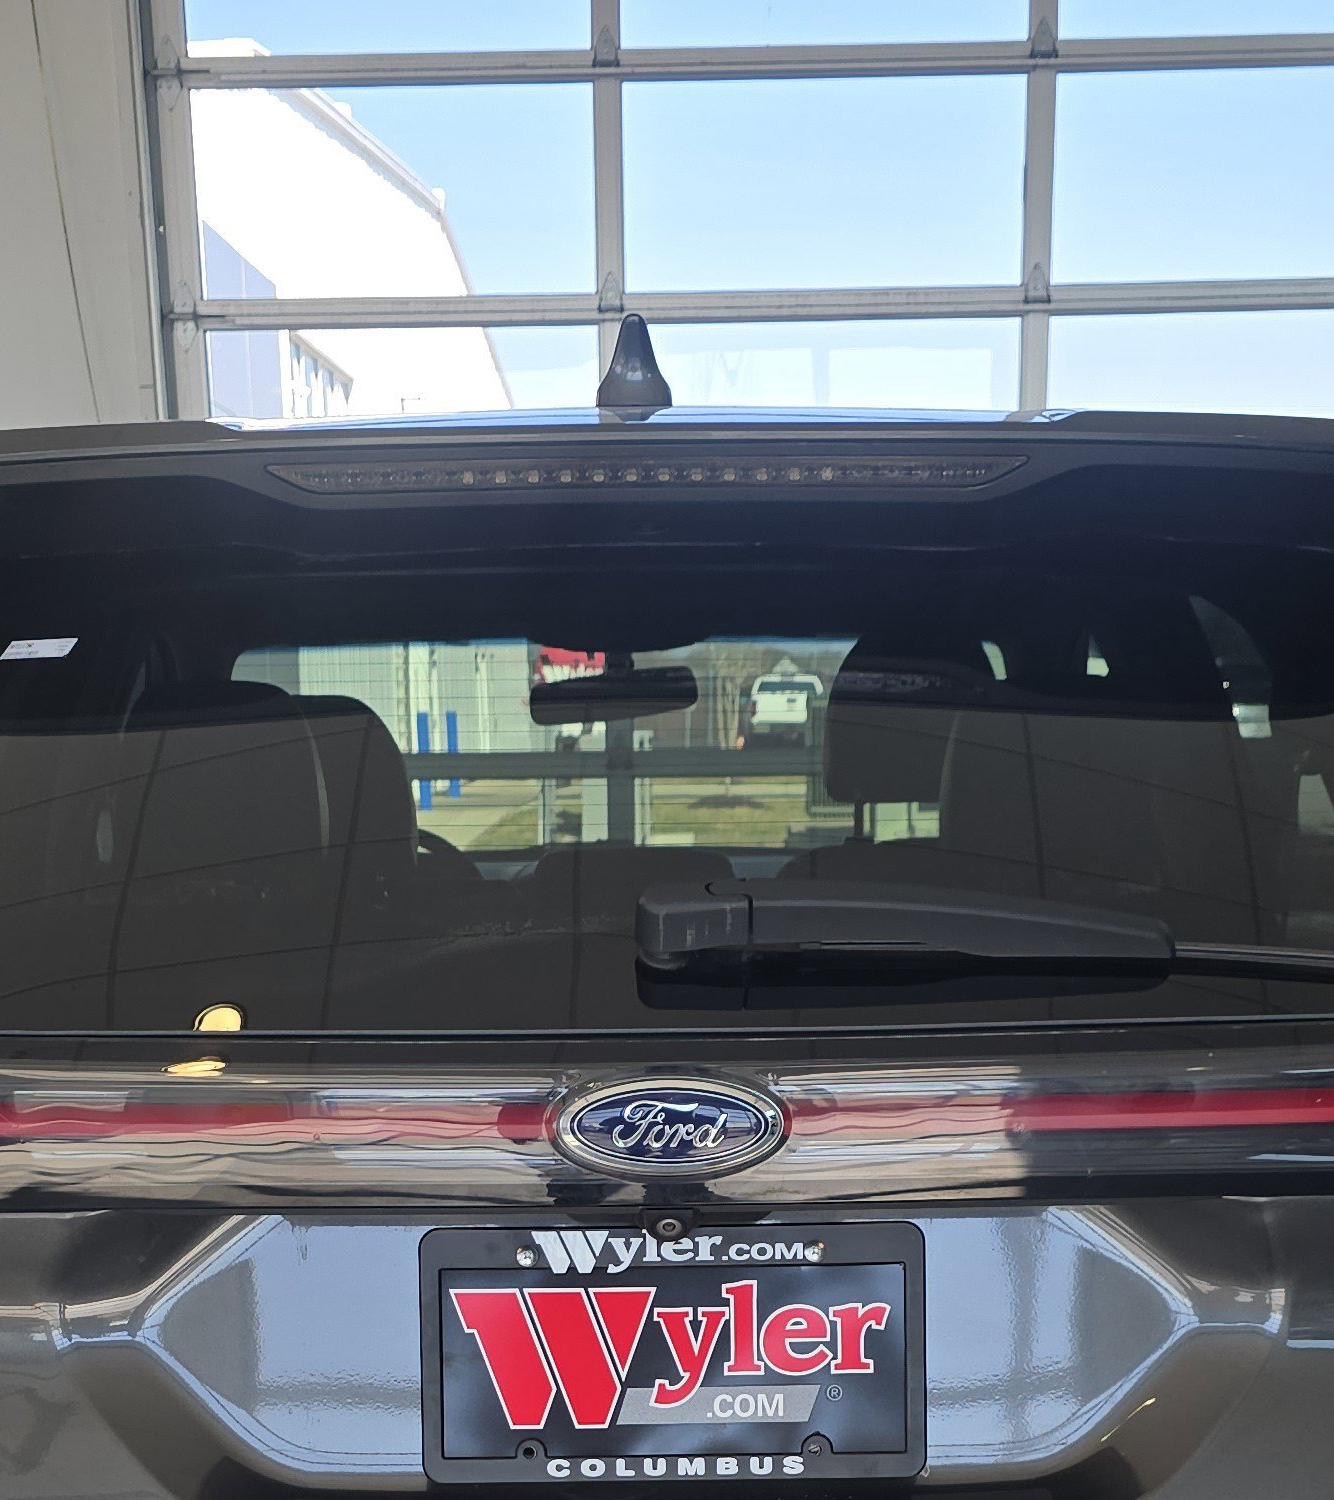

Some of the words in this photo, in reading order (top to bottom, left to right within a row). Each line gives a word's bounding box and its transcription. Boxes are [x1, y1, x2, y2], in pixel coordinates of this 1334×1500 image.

[612, 1100, 728, 1148] Ford
[449, 1280, 891, 1429] Wyler
[547, 1456, 805, 1478] COLUMBUS
